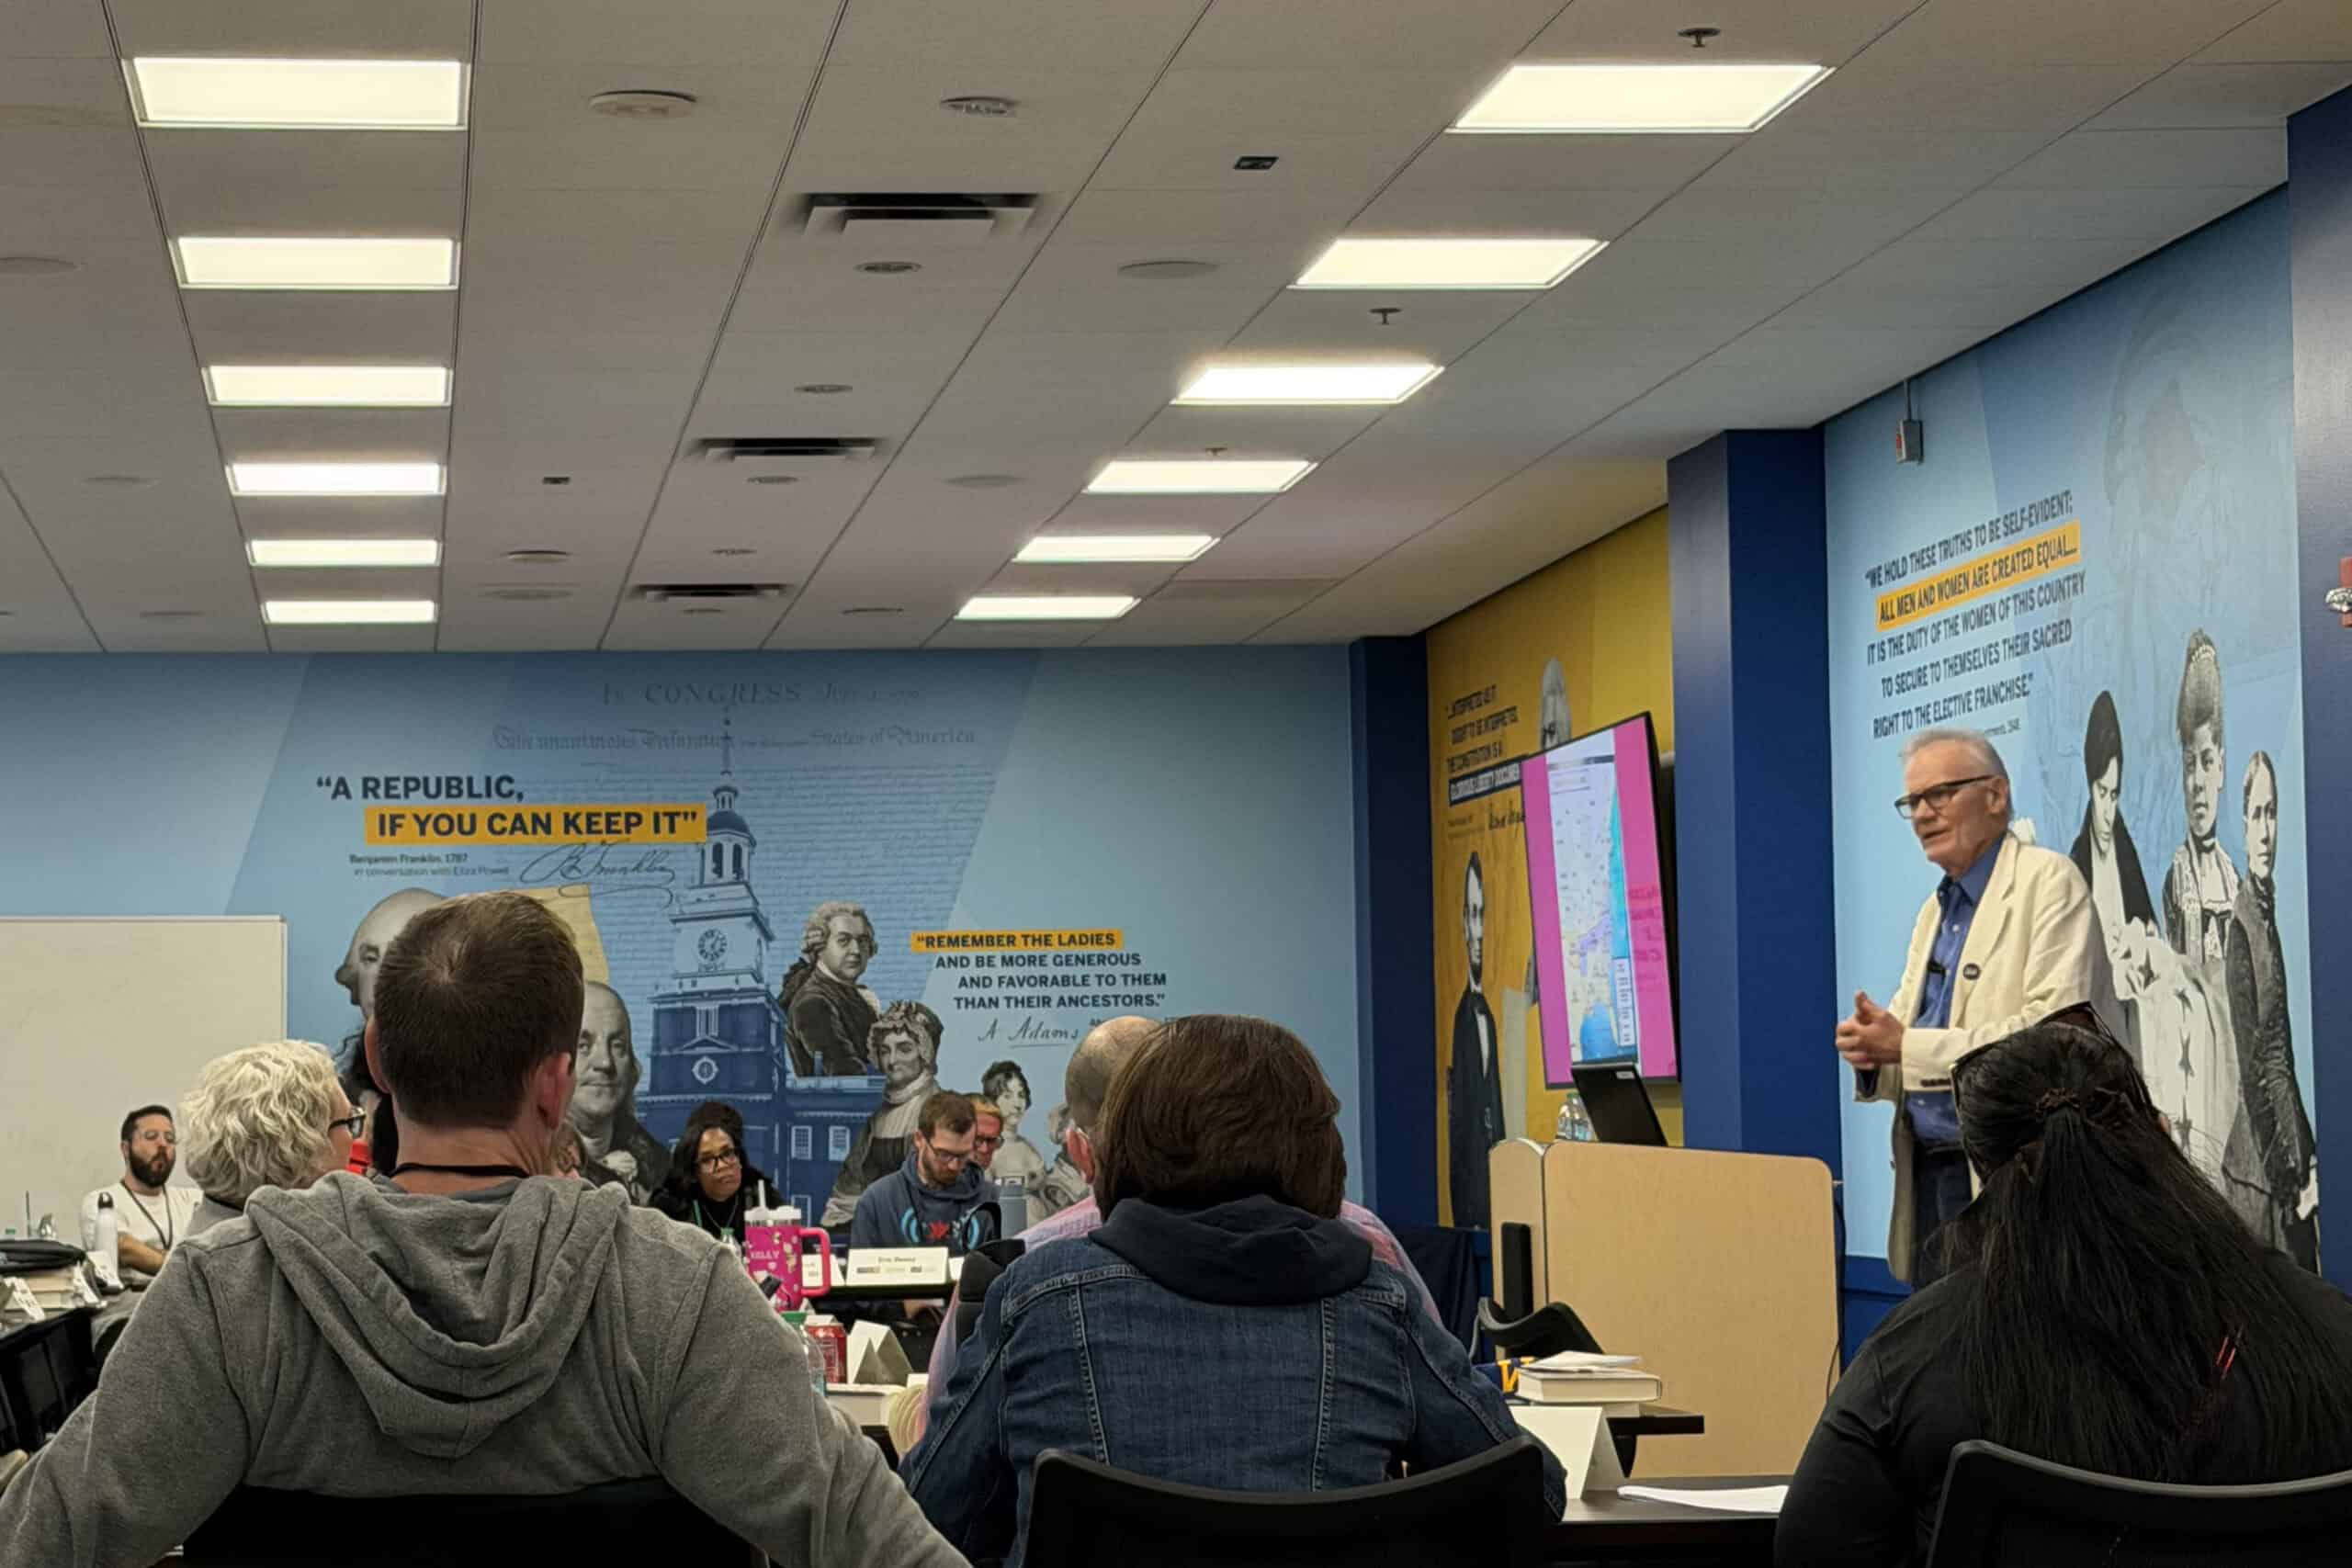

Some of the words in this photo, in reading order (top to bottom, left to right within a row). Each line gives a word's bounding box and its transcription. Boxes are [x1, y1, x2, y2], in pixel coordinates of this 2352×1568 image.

[1885, 556, 1908, 581] HOLD
[1910, 545, 1937, 574] THESE
[1939, 530, 1973, 563] TRUTHS
[1975, 524, 1987, 547] TO
[1989, 518, 2001, 542] BE
[1879, 600, 1895, 623] ALL
[1896, 593, 1916, 617] MEN
[1917, 585, 1936, 611] AND
[1938, 575, 1970, 605] WOMEN
[1972, 564, 1990, 589] ARE
[1992, 547, 2034, 583] CREATED
[1867, 643, 1875, 665] IT
[1877, 640, 1885, 661] IS
[1887, 635, 1905, 659] THE
[1906, 626, 1928, 653] DUTY
[1930, 620, 1941, 645] OF
[1942, 615, 1960, 641] THE
[1962, 602, 1996, 636] WOMEN
[1998, 595, 2011, 621] OF
[2012, 589, 2035, 615] THIS
[2037, 570, 2086, 609] COUNTRY
[1882, 677, 1894, 698] TO
[1895, 667, 1928, 695] SECURE
[1929, 661, 1941, 683] TO
[1943, 642, 2000, 680] THEMSELVES
[2002, 630, 2030, 660] THEIR
[2032, 617, 2072, 653] SACRED
[1873, 712, 1901, 739] RIGHT
[1902, 708, 1913, 730] TO
[1915, 702, 1931, 726] THE
[1933, 690, 1973, 721] ELECTIVE
[316, 776, 353, 800] “A
[361, 775, 525, 802] REPUBLIC,
[379, 813, 406, 837] IF
[413, 813, 477, 837] YOU
[486, 812, 552, 836] CAN
[562, 811, 643, 835] KEEP
[652, 810, 697, 834] IT”
[918, 934, 1017, 948] “REMEMBER
[1021, 933, 1054, 947] THE
[1057, 932, 1115, 946] LADIES
[935, 955, 970, 968] AND
[975, 954, 996, 967] BE
[1001, 953, 1048, 967] MORE
[1052, 953, 1141, 966] GENEROUS
[958, 976, 992, 988] AND
[998, 974, 1091, 987] FAVORABLE
[1094, 974, 1116, 987] TO
[1121, 973, 1167, 986] THEM
[954, 996, 1000, 1010] THAN
[1004, 995, 1052, 1008] THEIR
[1057, 993, 1165, 1008] ANCESTORS.”
